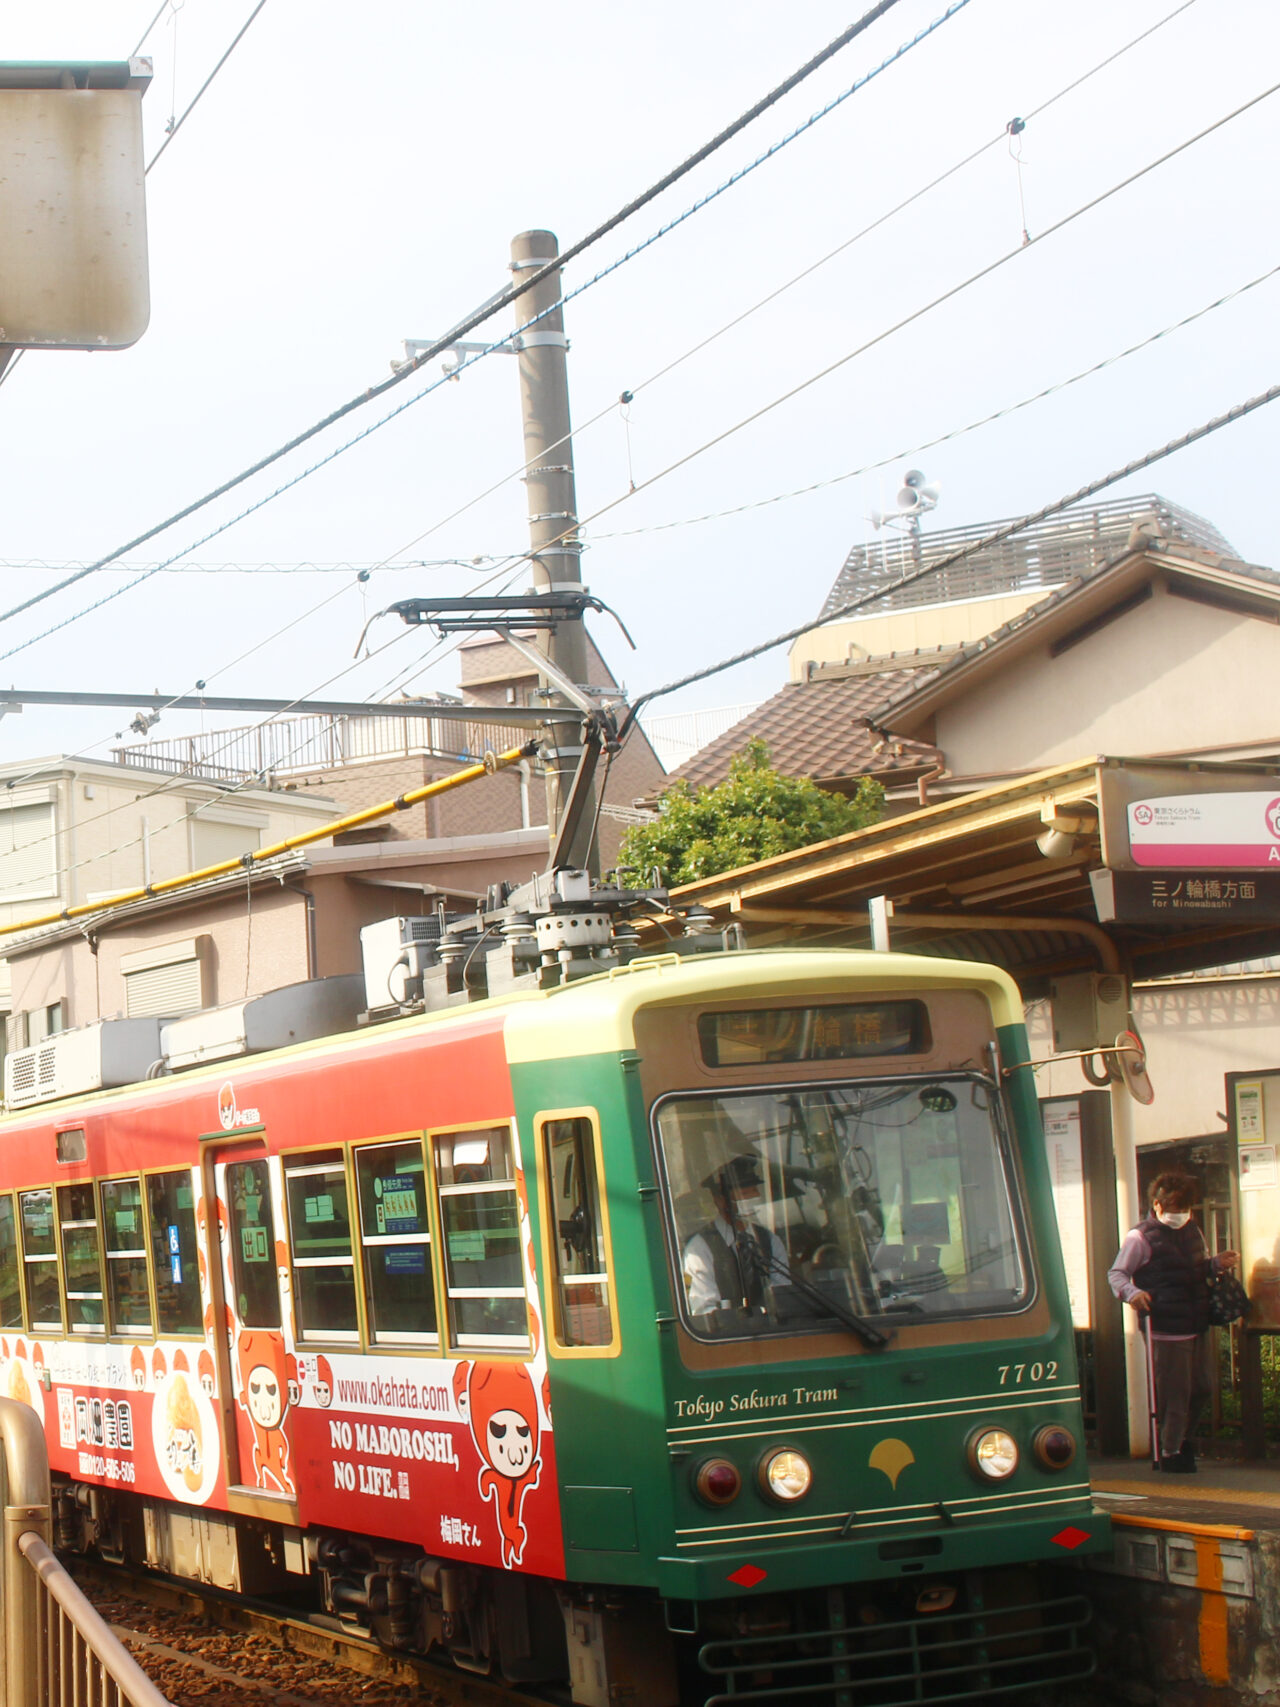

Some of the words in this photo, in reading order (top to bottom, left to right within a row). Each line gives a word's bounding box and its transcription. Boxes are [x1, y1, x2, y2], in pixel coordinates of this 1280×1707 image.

[1138, 811, 1148, 819] SA
[1152, 880, 1255, 899] 三ノ輪橋方面
[1152, 899, 1168, 908] for
[244, 1231, 266, 1258] 出口
[998, 1361, 1058, 1385] 7702
[337, 1376, 450, 1412] www.okahata.com
[674, 1397, 724, 1422] Tokyo
[730, 1389, 787, 1412] Sakura
[793, 1385, 838, 1405] Tram
[329, 1420, 352, 1450] NO
[355, 1423, 460, 1472] MABOROSHI,
[332, 1461, 356, 1491] NO
[358, 1464, 398, 1499] LIFE.
